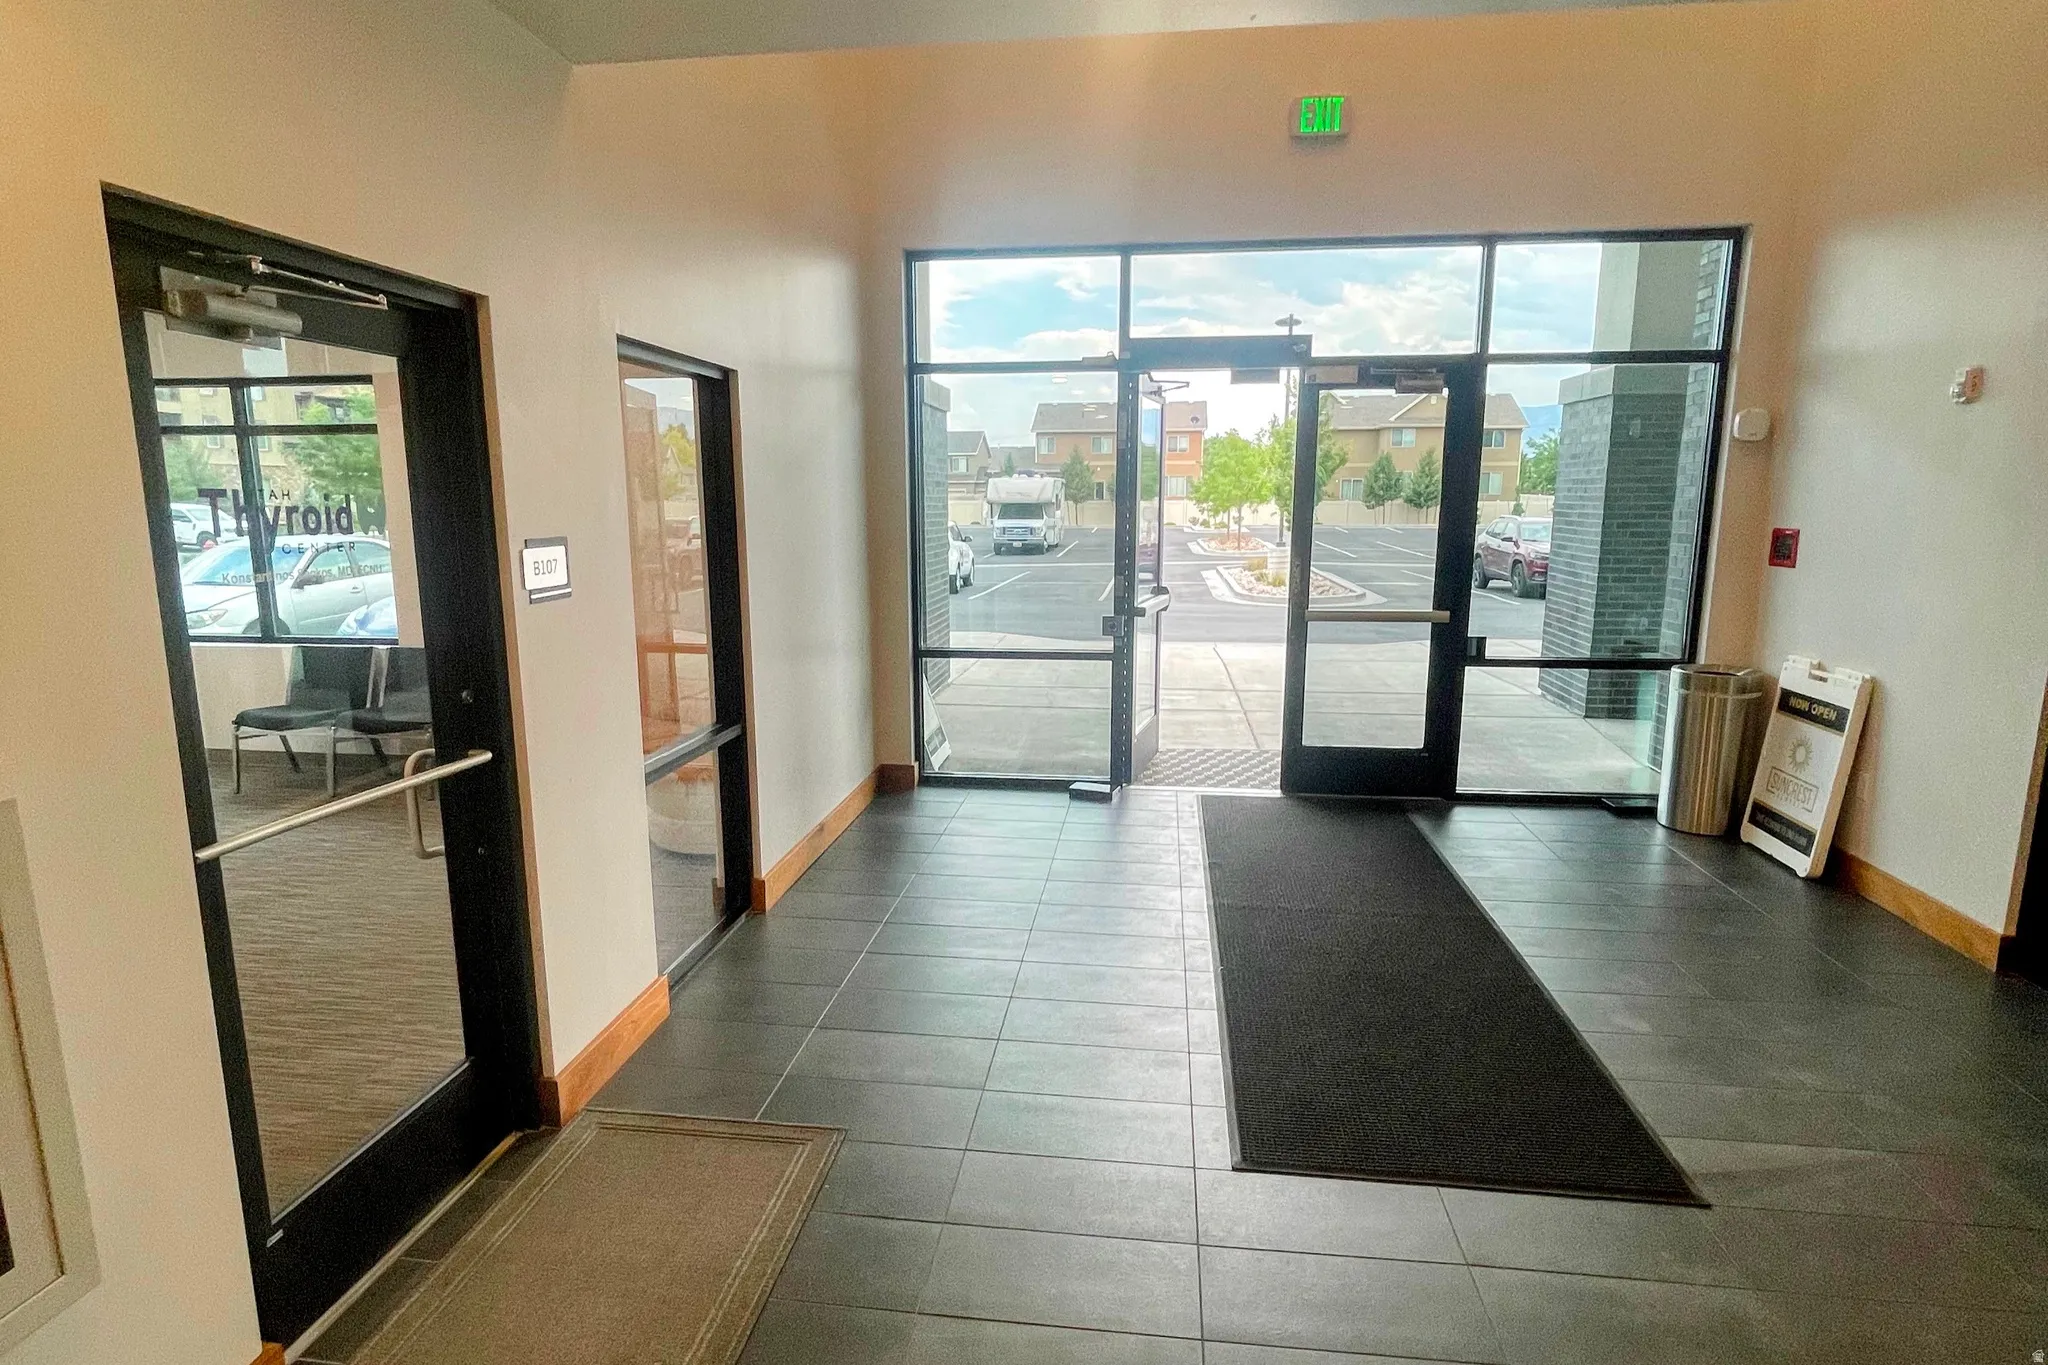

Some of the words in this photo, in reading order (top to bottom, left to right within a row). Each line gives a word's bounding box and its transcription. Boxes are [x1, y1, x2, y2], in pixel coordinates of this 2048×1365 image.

[1301, 97, 1345, 132] EXIT
[198, 488, 354, 554] Thyroid
[282, 541, 356, 555] CENTER
[533, 558, 558, 576] B107
[1789, 696, 1810, 711] NOW
[1811, 703, 1838, 721] OPEN
[1770, 772, 1813, 805] SUNCREST
